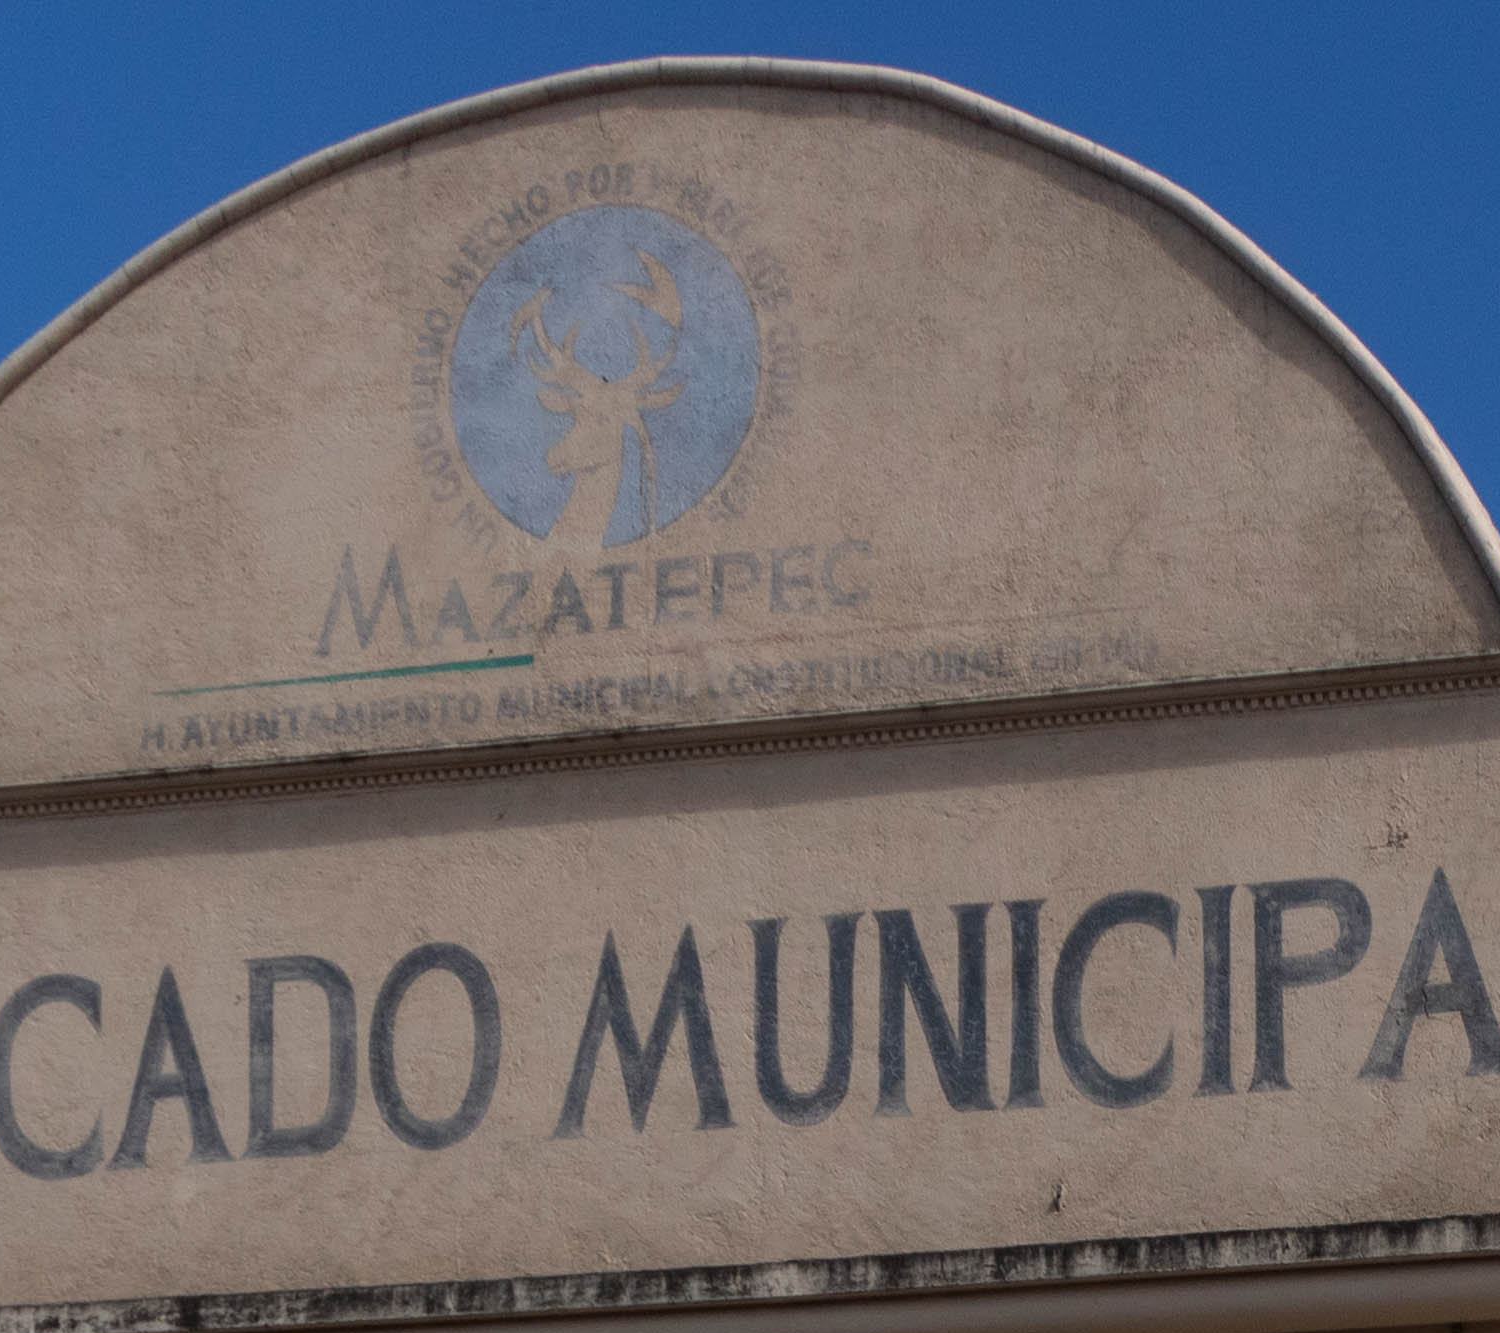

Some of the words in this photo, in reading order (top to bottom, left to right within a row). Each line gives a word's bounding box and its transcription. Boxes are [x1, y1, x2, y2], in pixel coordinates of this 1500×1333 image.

[564, 161, 636, 200] POR
[314, 537, 872, 658] MAZATEPEC
[180, 688, 482, 750] AYUNTAMIENTO
[498, 666, 691, 718] MUNICIPAL
